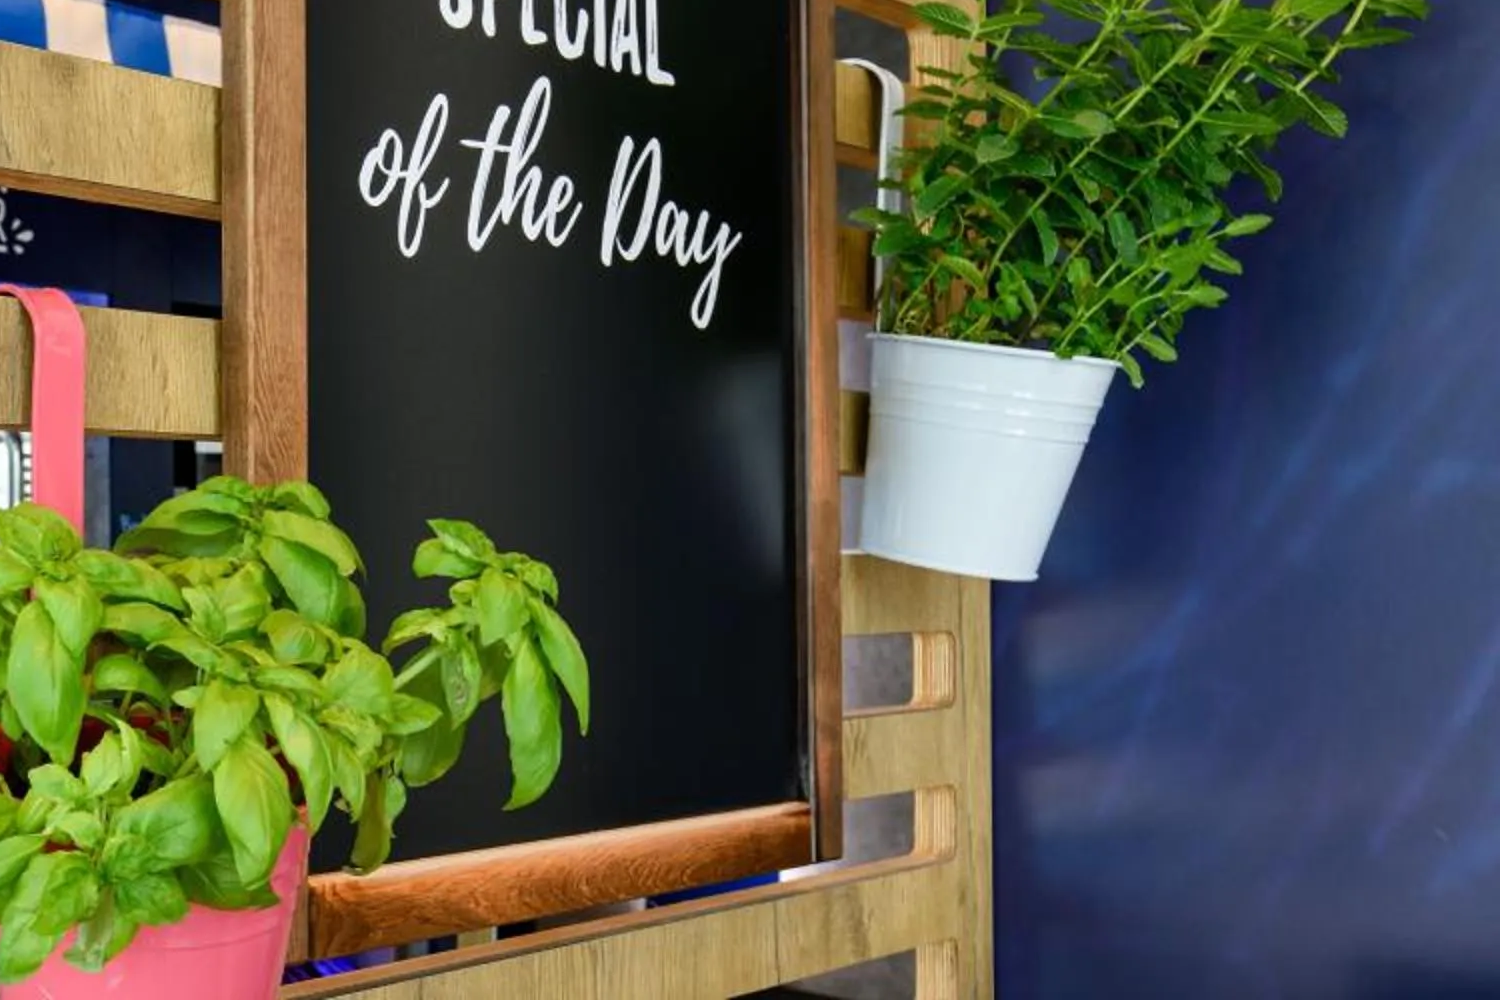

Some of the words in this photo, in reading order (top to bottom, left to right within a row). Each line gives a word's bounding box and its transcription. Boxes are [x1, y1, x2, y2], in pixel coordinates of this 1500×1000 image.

[358, 93, 449, 258] of
[460, 76, 583, 251] the
[601, 135, 743, 329] Day
